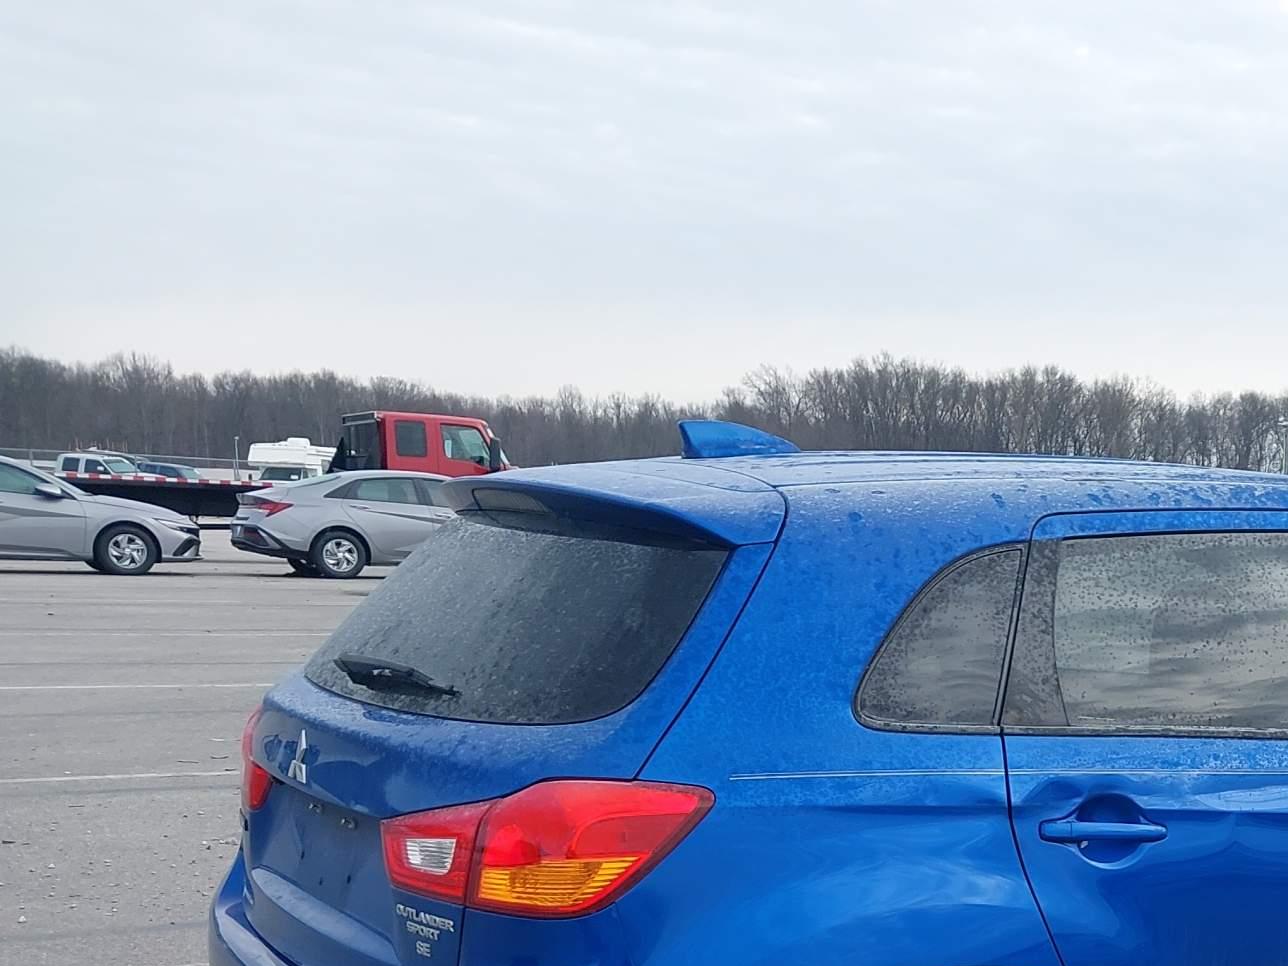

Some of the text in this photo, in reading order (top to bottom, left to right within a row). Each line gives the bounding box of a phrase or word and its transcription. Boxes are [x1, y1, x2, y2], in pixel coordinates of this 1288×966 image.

[396, 903, 454, 932] OUTLANDER
[406, 921, 440, 940] SPORT
[415, 940, 431, 957] SE
